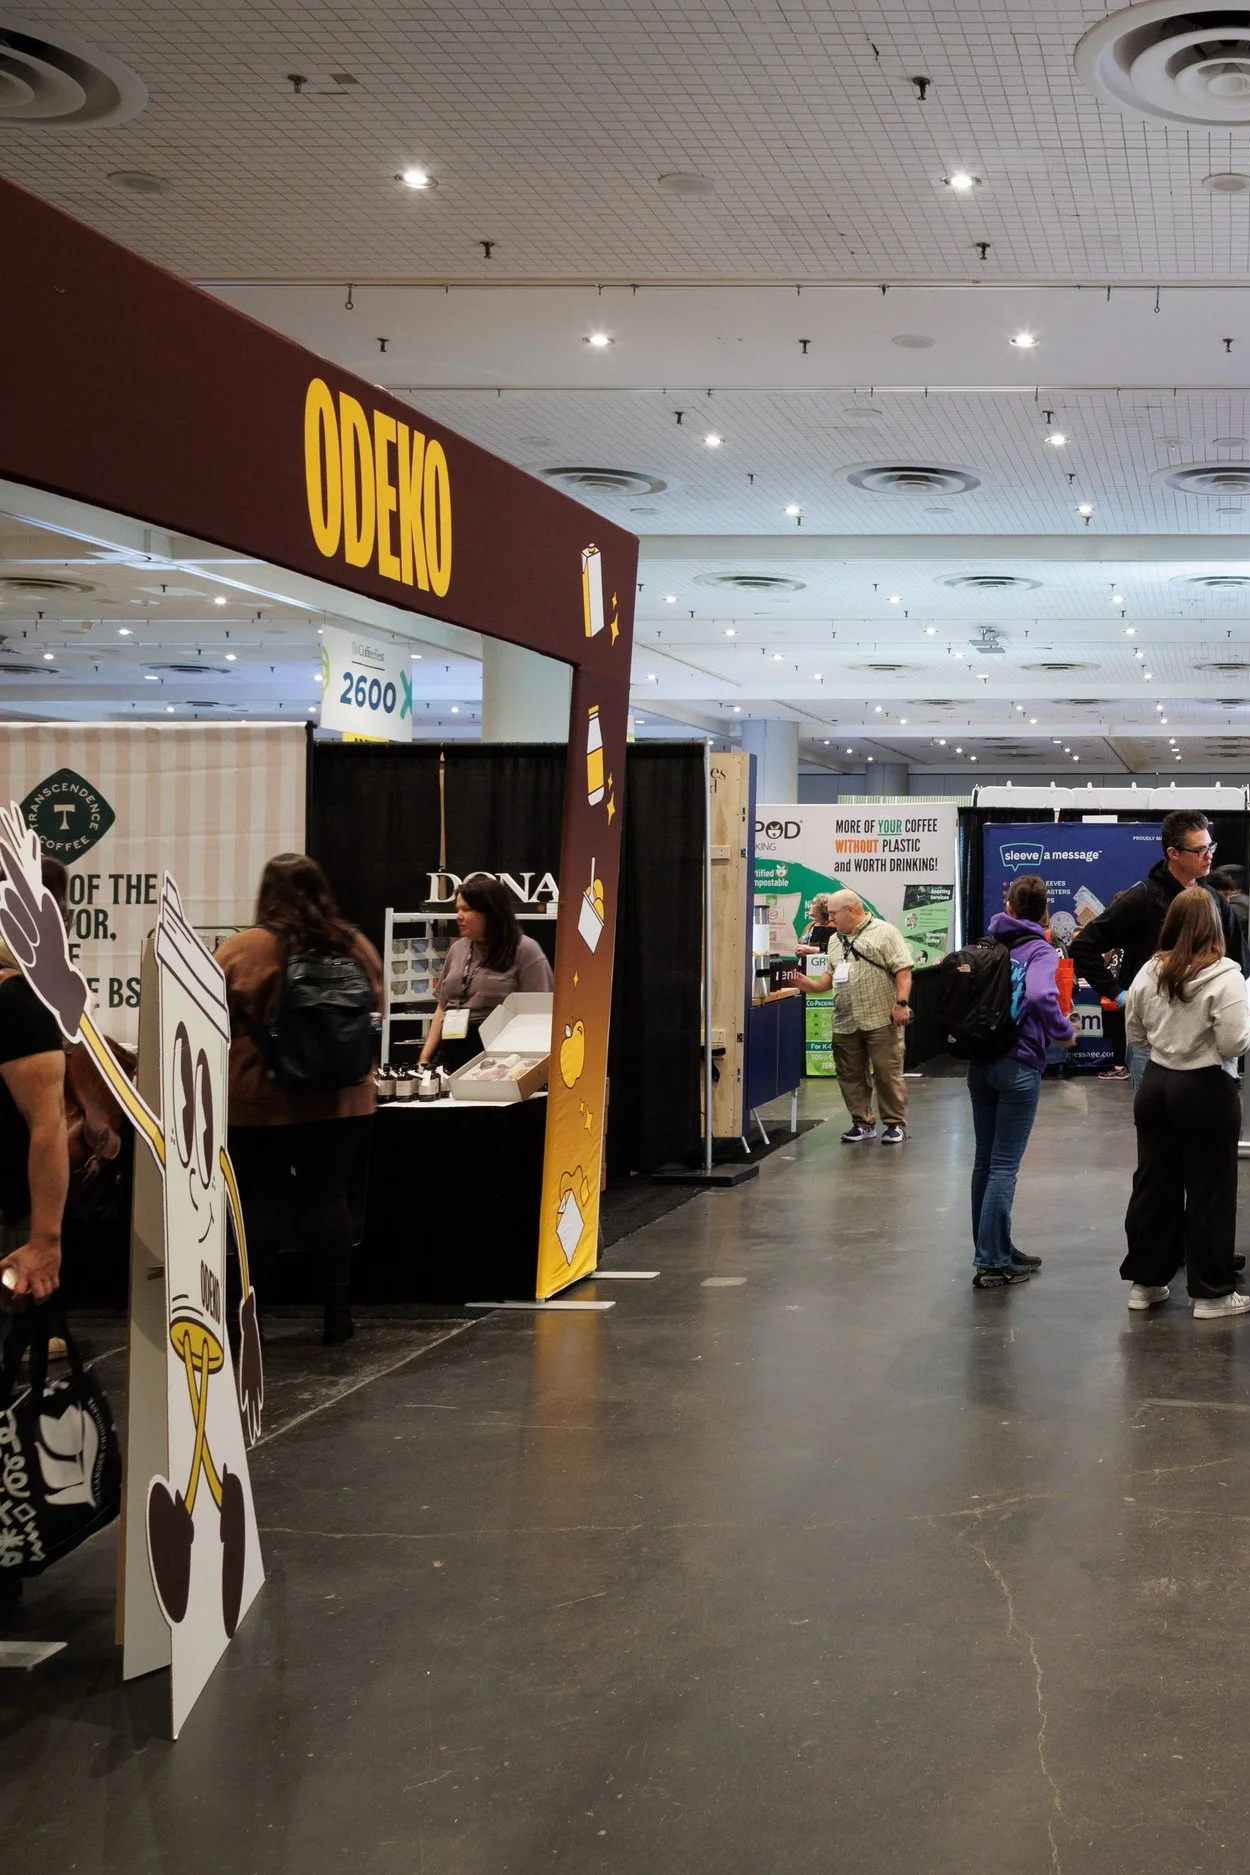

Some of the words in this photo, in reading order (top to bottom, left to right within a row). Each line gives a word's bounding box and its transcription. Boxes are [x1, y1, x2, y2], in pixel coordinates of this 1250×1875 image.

[304, 377, 453, 598] ODEKO
[340, 672, 397, 714] 2600
[28, 782, 100, 831] TRANSCENDENCE
[836, 820, 861, 833] MORE
[864, 820, 875, 833] OF
[877, 819, 902, 834] YOUR
[905, 819, 938, 832] COFFEE
[40, 835, 90, 852] COFFEE
[835, 840, 879, 853] WITHOUT
[882, 839, 920, 852] PLASTIC
[834, 860, 851, 872] and
[854, 859, 886, 872] WORTH
[889, 858, 938, 872] DRINKING!
[1005, 850, 1039, 860] sleeve
[1053, 850, 1099, 862] message
[70, 874, 101, 905] OF
[108, 874, 158, 905] THE
[425, 872, 559, 903] DNA
